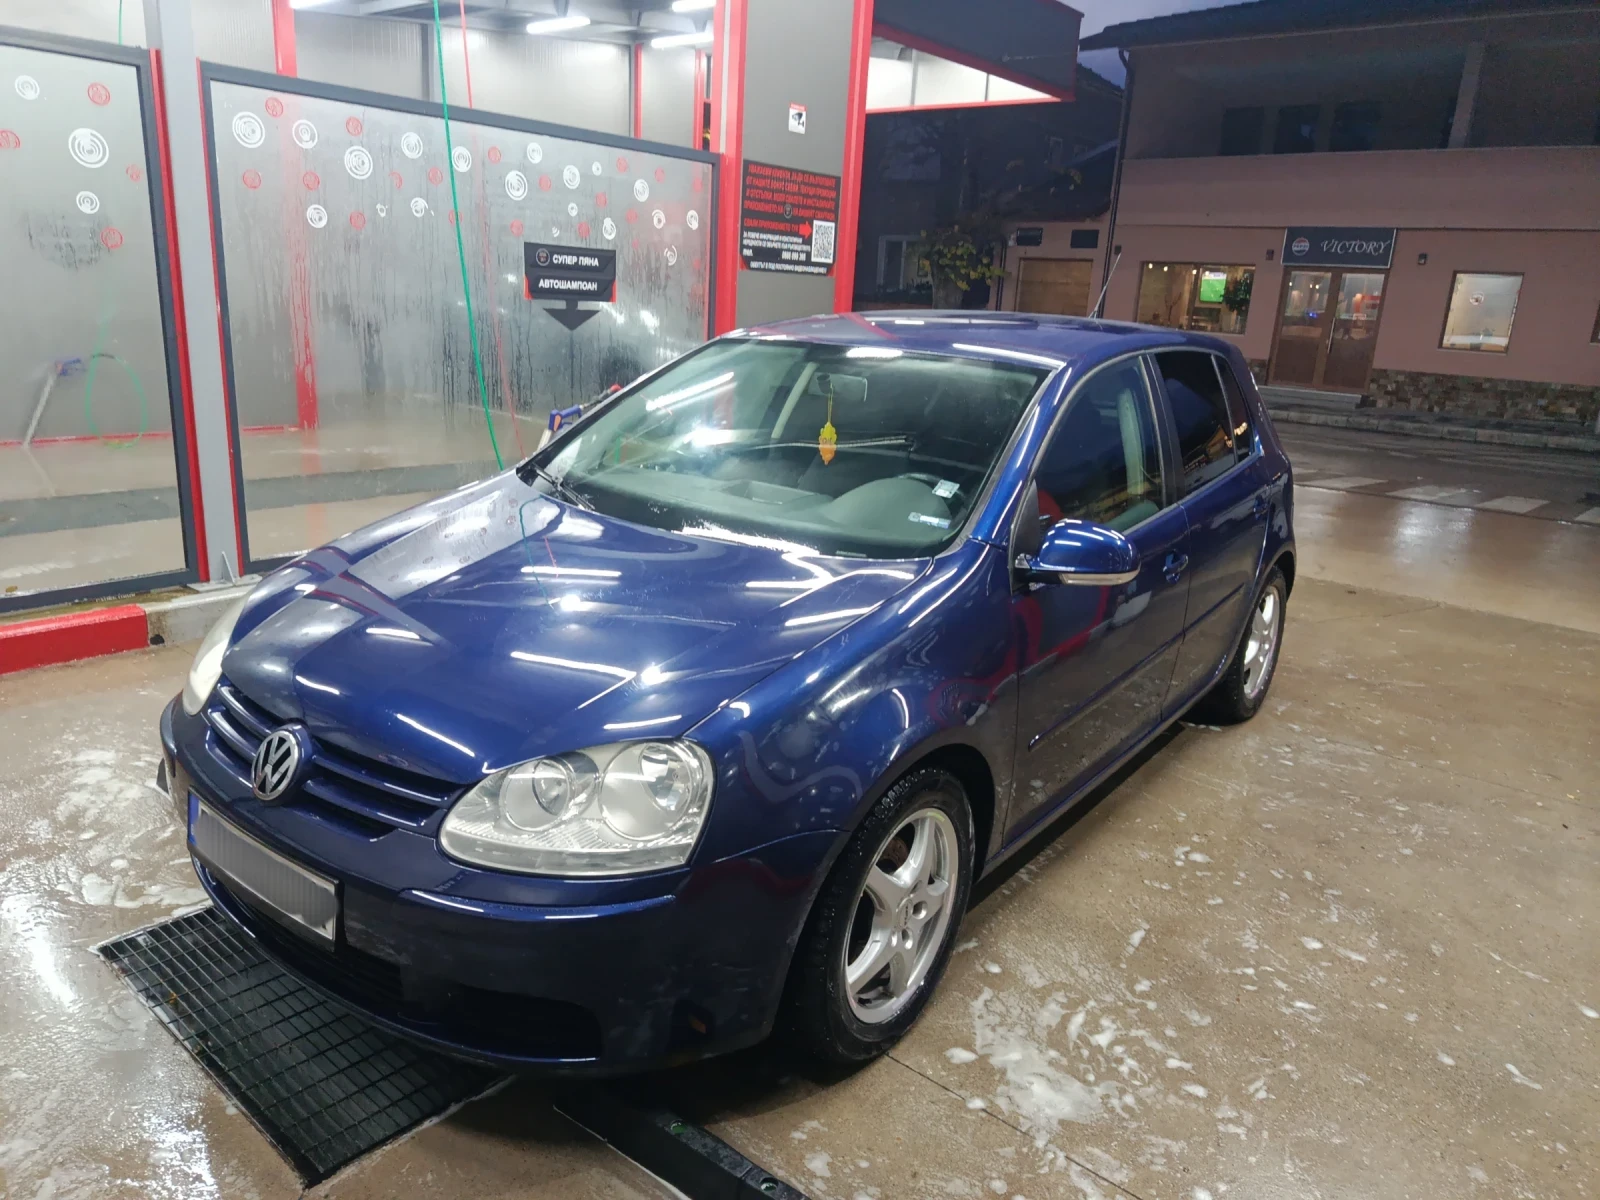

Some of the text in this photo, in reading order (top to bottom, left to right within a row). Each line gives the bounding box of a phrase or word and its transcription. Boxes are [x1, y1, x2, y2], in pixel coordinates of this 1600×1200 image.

[1321, 239, 1391, 256] VICTORY
[553, 254, 578, 266] СУПЕР
[578, 256, 599, 267] ПЯНА
[538, 278, 598, 291] АВТОШАМПОАН
